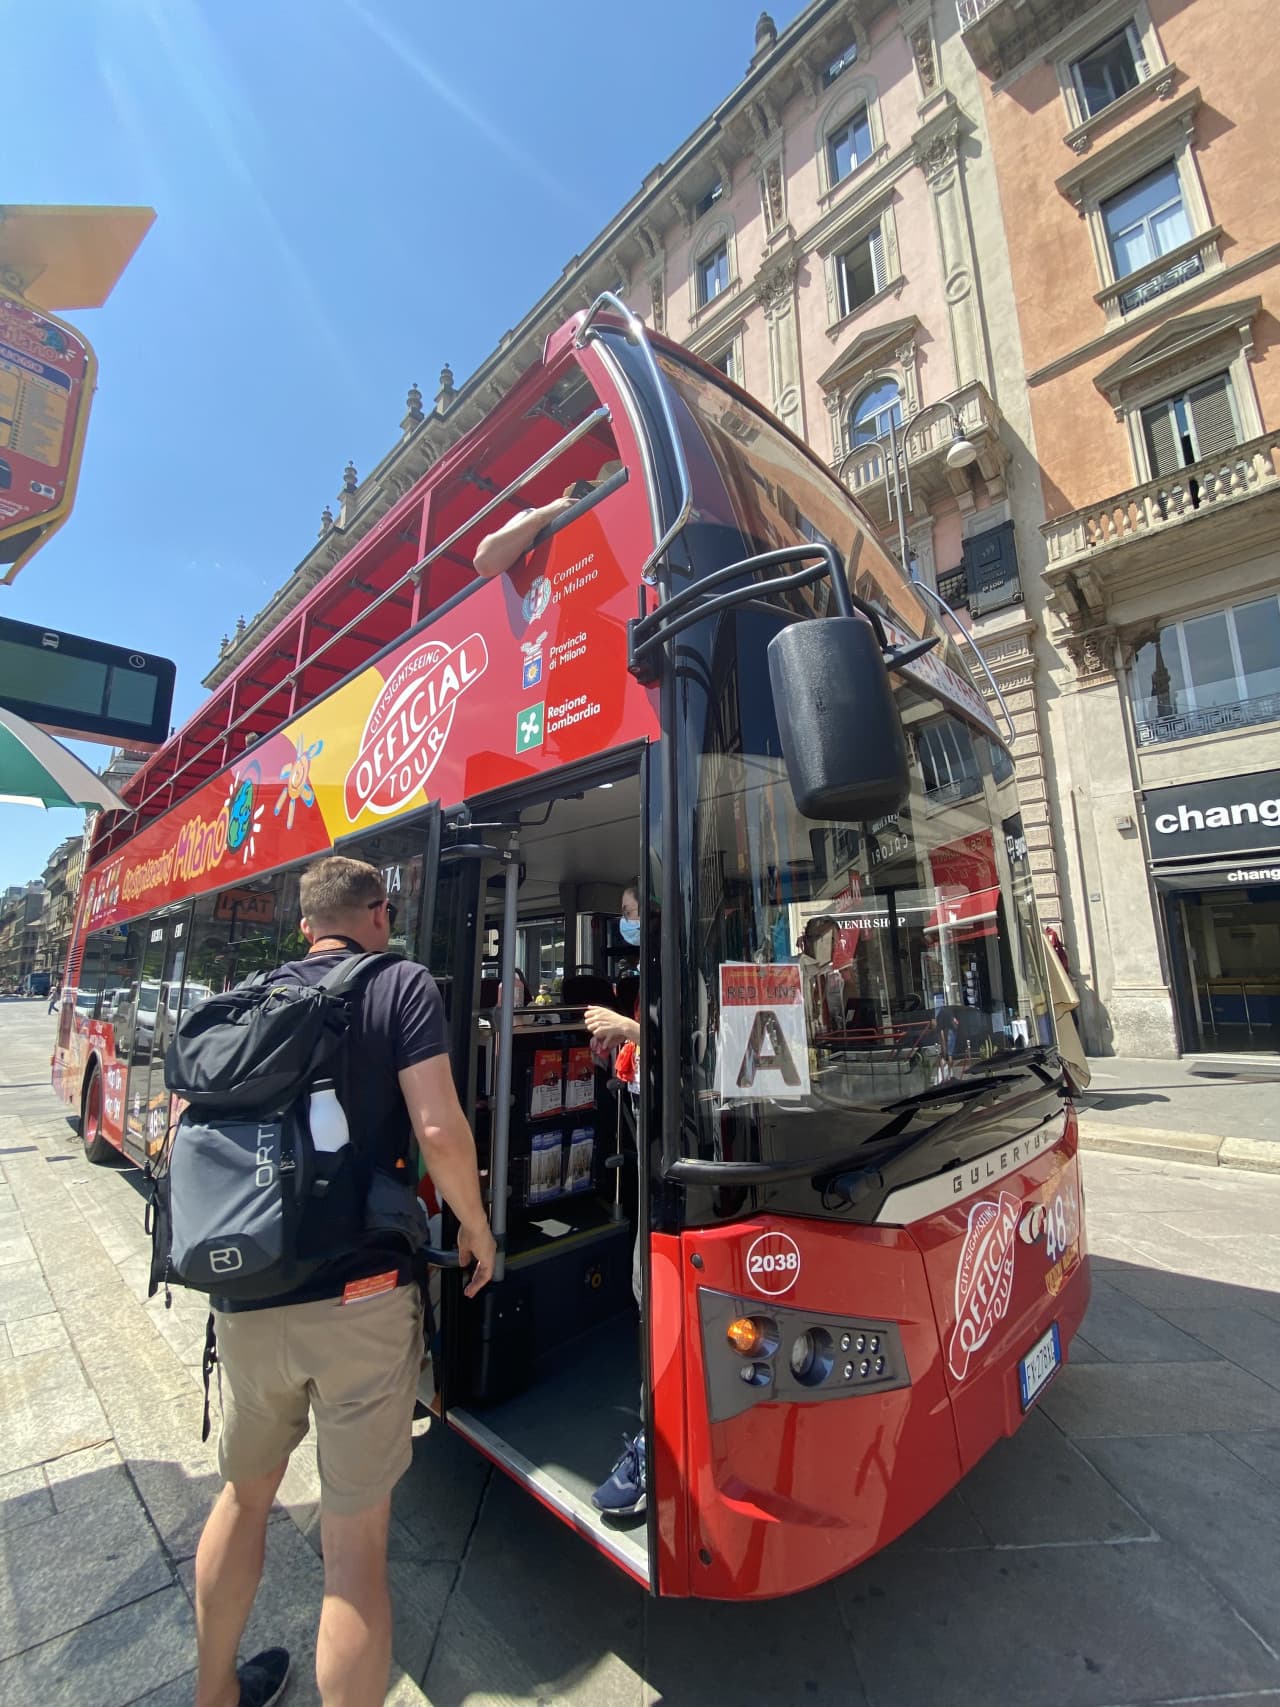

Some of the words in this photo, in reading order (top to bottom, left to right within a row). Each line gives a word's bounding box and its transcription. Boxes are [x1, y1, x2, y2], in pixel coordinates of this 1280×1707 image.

[553, 553, 594, 585] Comune
[552, 589, 562, 604] di
[563, 569, 598, 600] Milano
[549, 631, 587, 658] Provincia
[549, 657, 557, 671] di
[559, 644, 586, 667] Milano
[370, 648, 440, 735] CITYSIGHTSEEING
[547, 694, 587, 719] Regione
[356, 649, 477, 799] OFFICIAL
[547, 702, 600, 733] Lombardia
[389, 726, 444, 798] TOUR
[873, 917, 906, 928] SHP
[727, 986, 756, 999] RED
[736, 1010, 801, 1088] A
[750, 1253, 797, 1272] 2038
[961, 1206, 997, 1294] CITYSIGHTSEEING
[960, 1202, 1019, 1351] OFFICIAL
[987, 1259, 1013, 1327] TOUR
